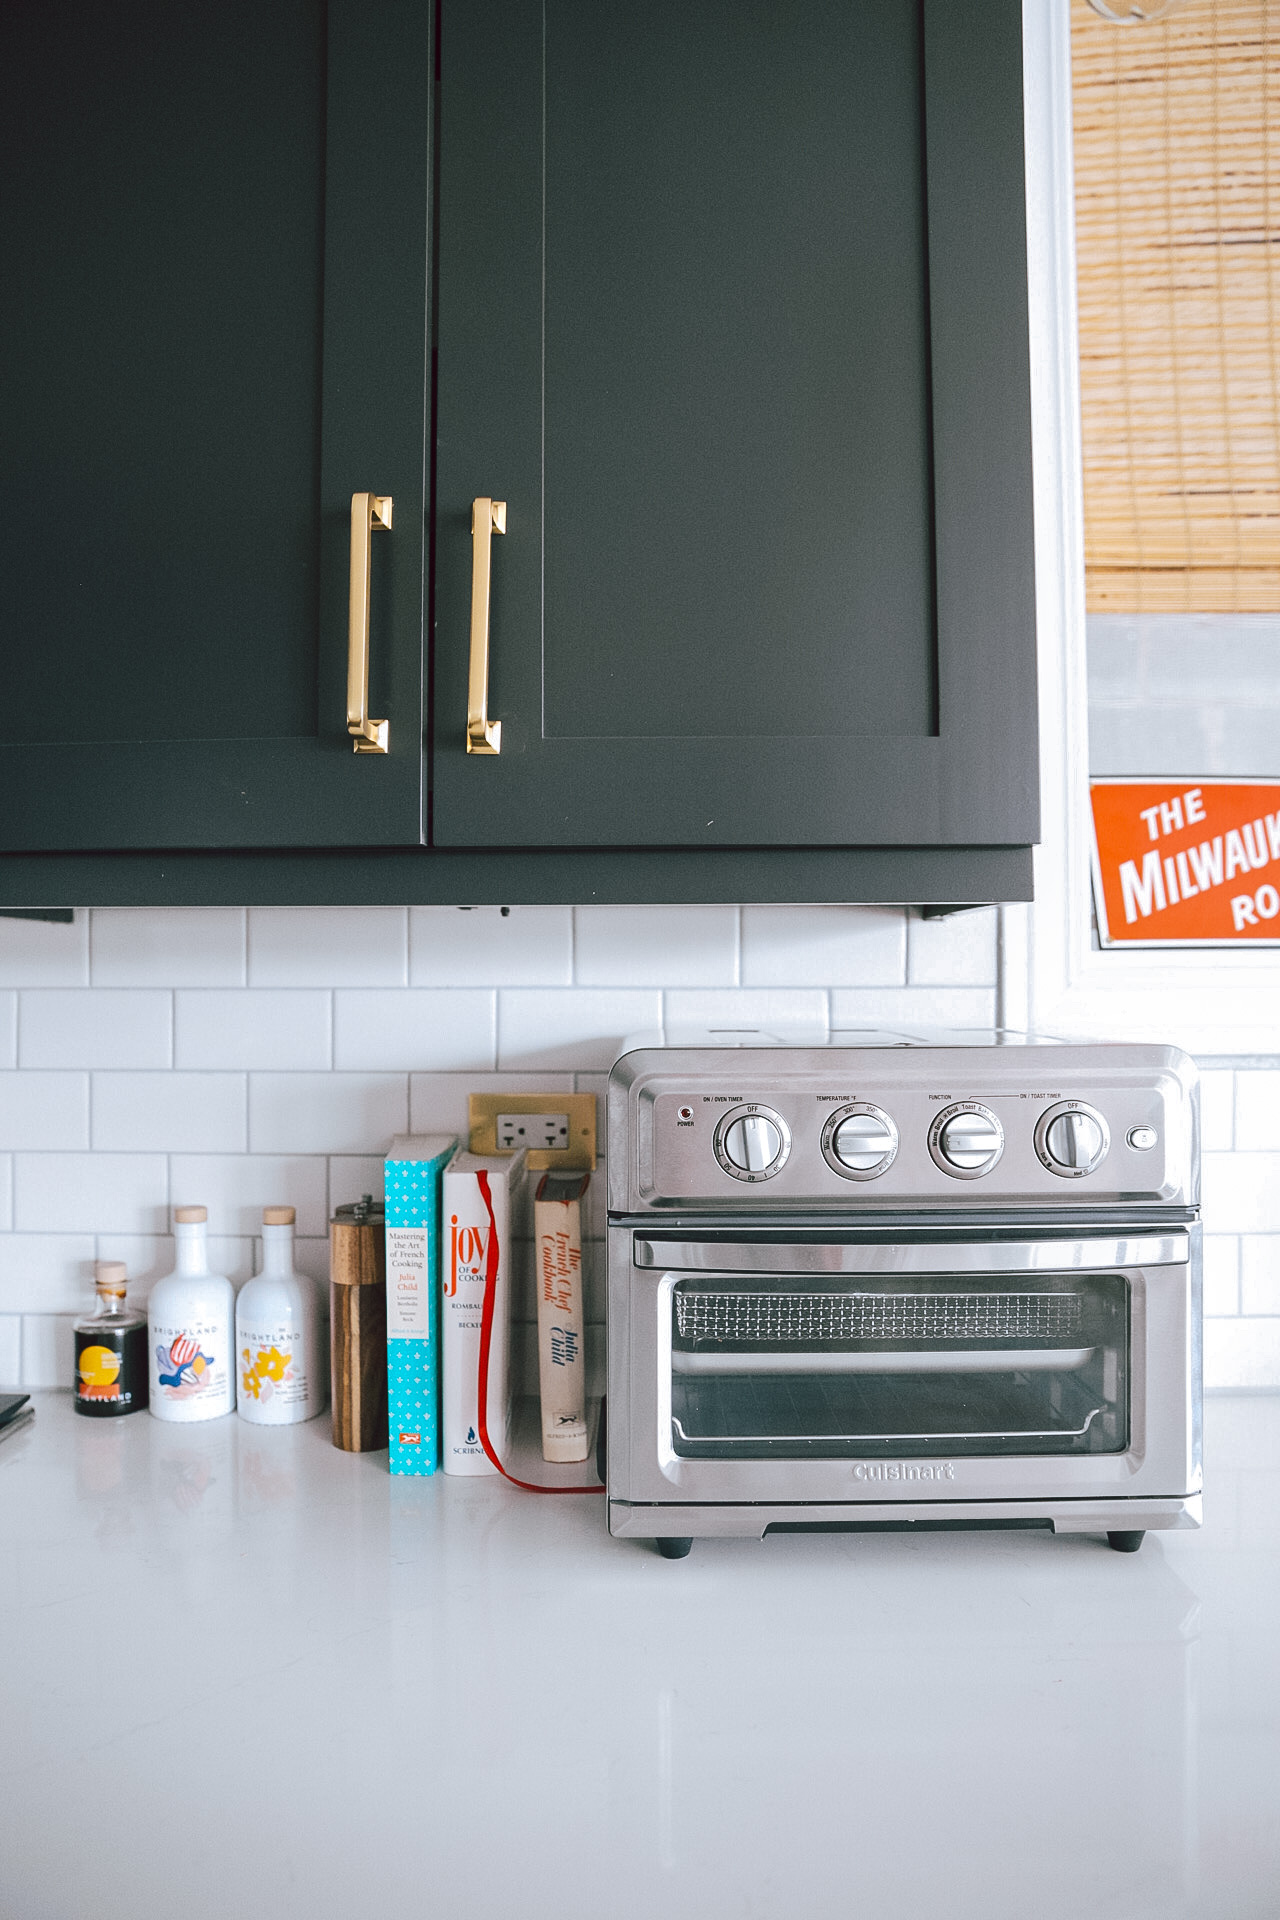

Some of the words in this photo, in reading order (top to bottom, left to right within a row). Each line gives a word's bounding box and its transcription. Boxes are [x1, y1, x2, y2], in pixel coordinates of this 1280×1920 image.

[1140, 788, 1206, 841] THE
[1230, 884, 1280, 931] RO
[724, 1163, 732, 1171] 50
[389, 1233, 425, 1241] Mastering
[556, 1231, 571, 1276] French
[391, 1261, 423, 1269] Cooking
[444, 1214, 491, 1298] joy
[541, 1234, 558, 1304] Cookbook
[568, 1248, 581, 1270] The
[556, 1278, 572, 1314] Chef
[550, 1326, 565, 1366] Child
[563, 1328, 578, 1362] Julia
[852, 1462, 954, 1480] Cuisinart
